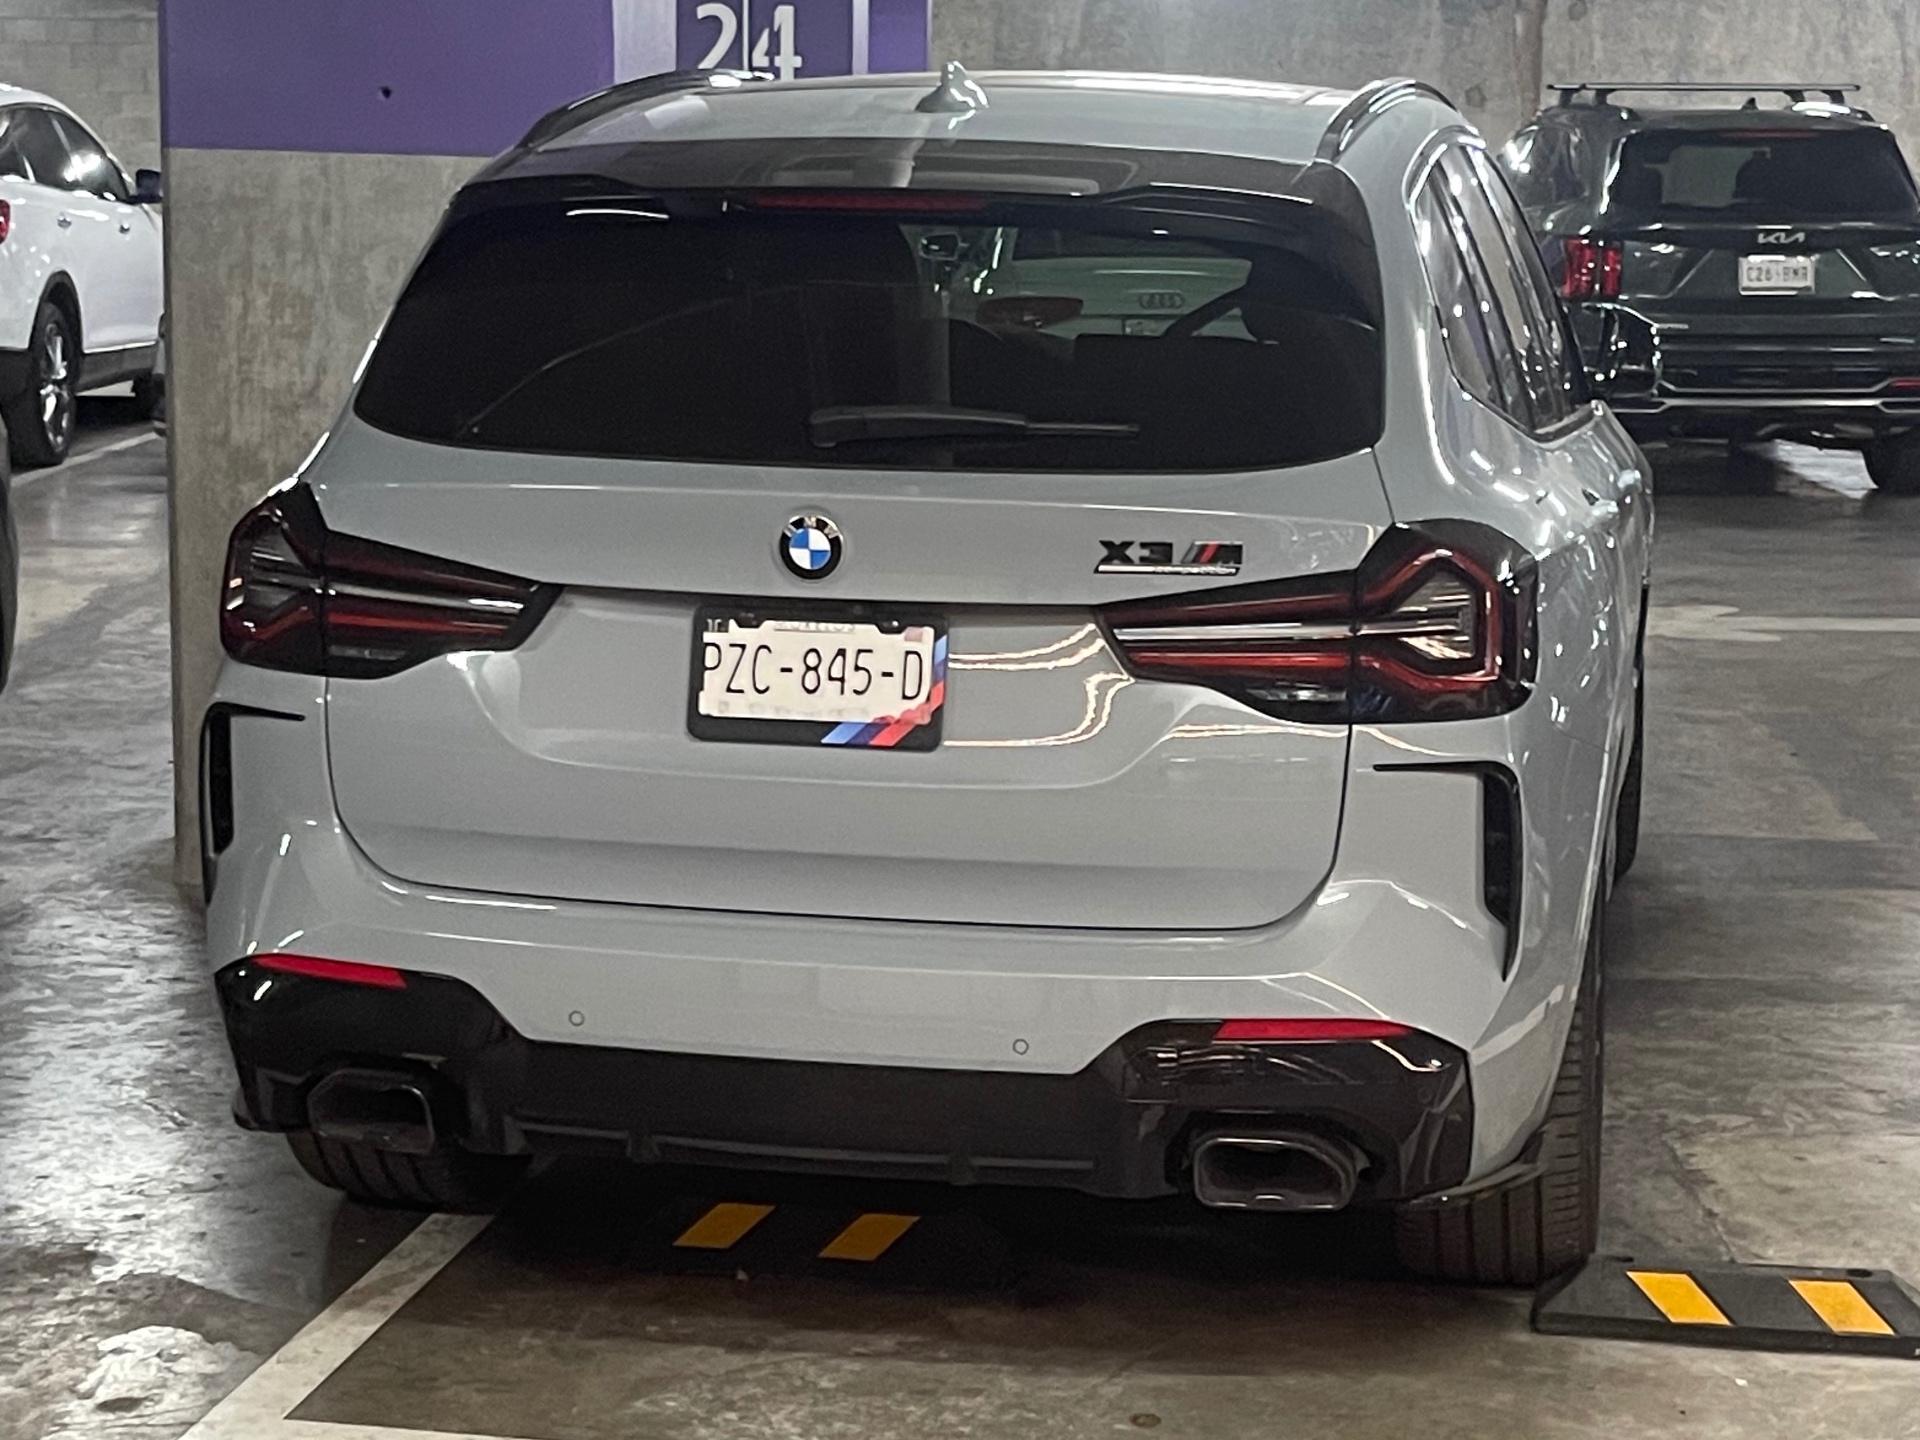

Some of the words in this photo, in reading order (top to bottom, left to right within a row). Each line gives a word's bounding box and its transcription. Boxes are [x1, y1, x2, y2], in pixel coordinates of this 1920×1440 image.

[696, 3, 802, 81] 24
[783, 515, 839, 539] BMW
[1098, 540, 1173, 564] X3
[702, 642, 923, 700] PZC-845-D
